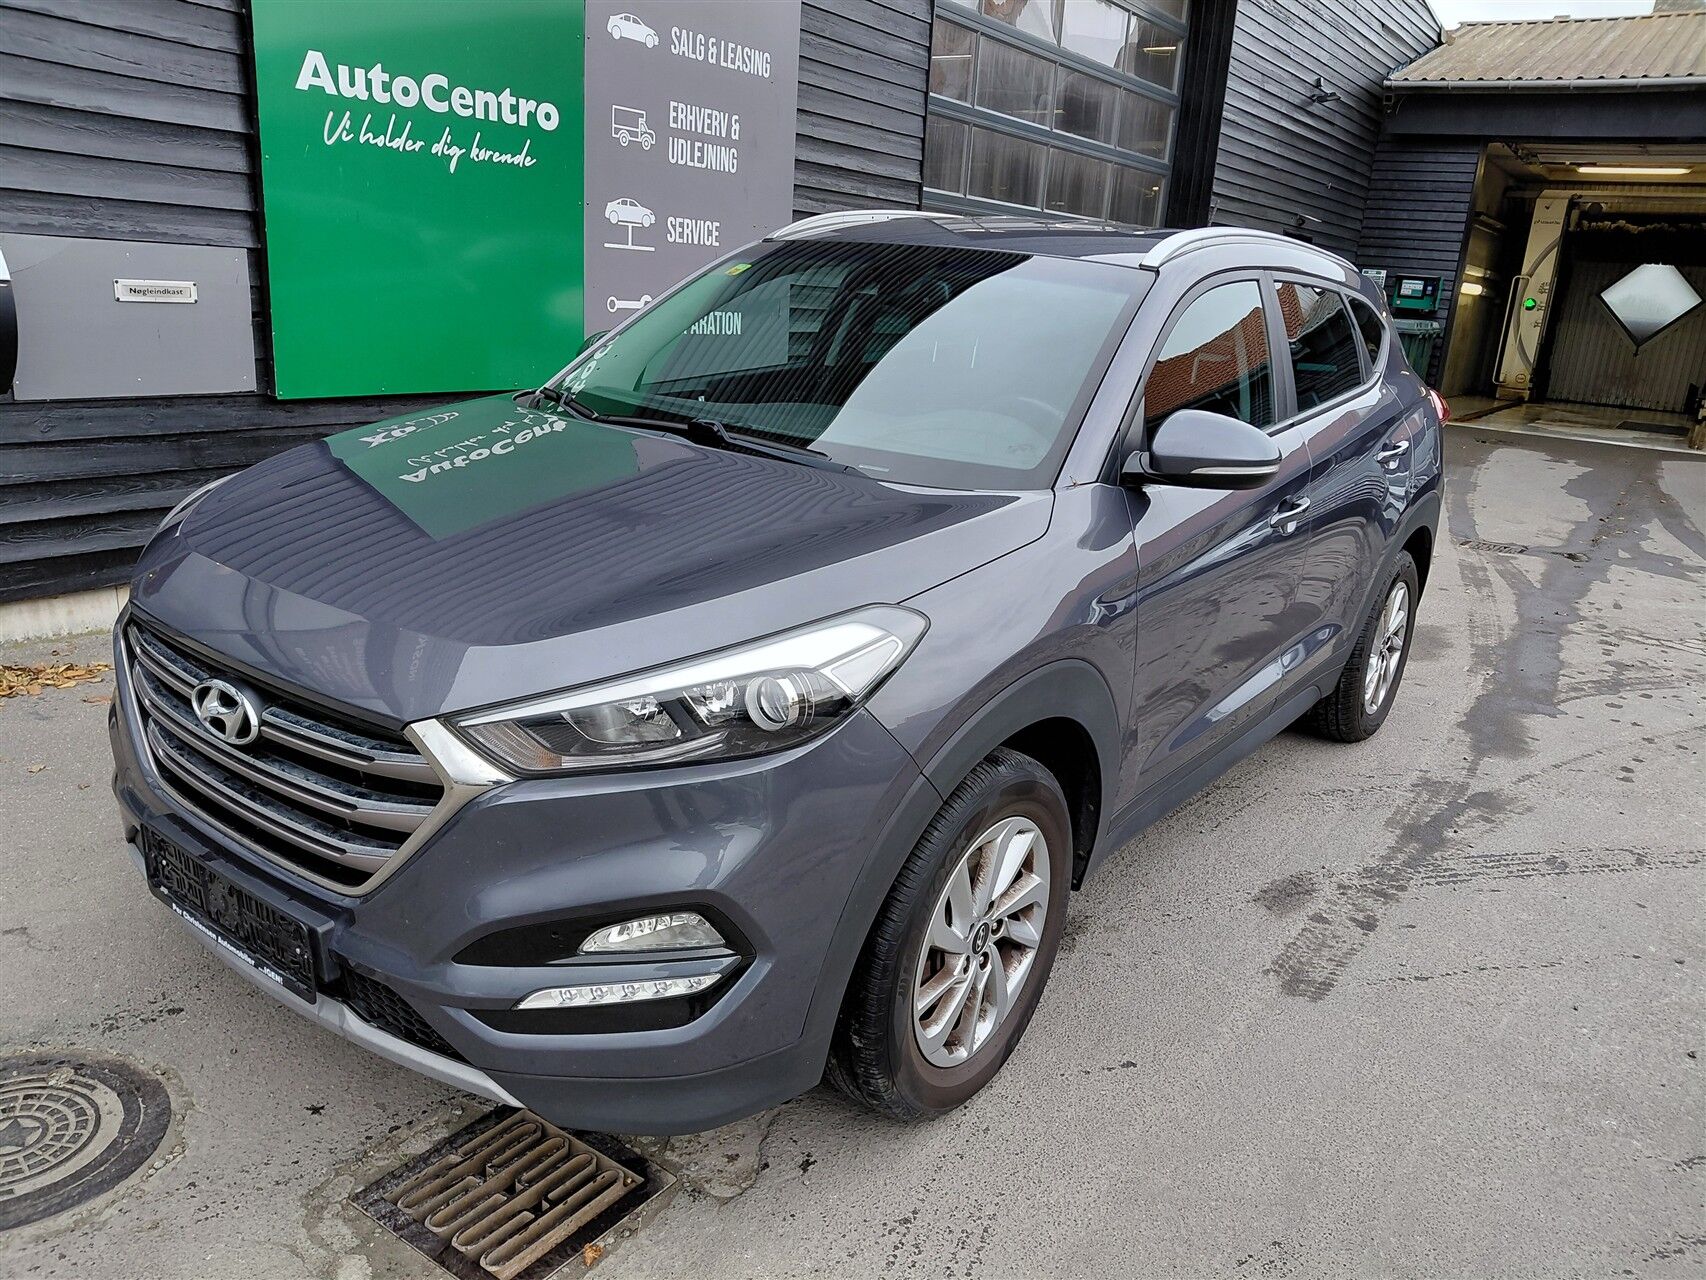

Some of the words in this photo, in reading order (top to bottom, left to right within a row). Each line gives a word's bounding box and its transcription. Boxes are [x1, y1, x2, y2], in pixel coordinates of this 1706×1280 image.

[670, 26, 705, 61] SALG
[707, 37, 718, 65] &
[720, 40, 771, 79] LEASING
[294, 49, 560, 131] AutoCentro
[669, 100, 728, 138] ERHVERV
[730, 114, 740, 141] &
[323, 110, 355, 146] Vi
[359, 113, 426, 152] holder
[431, 126, 467, 174] dig
[669, 137, 738, 174] UDLEJNING
[666, 216, 720, 247] SERVICE
[683, 311, 742, 336] ARATION
